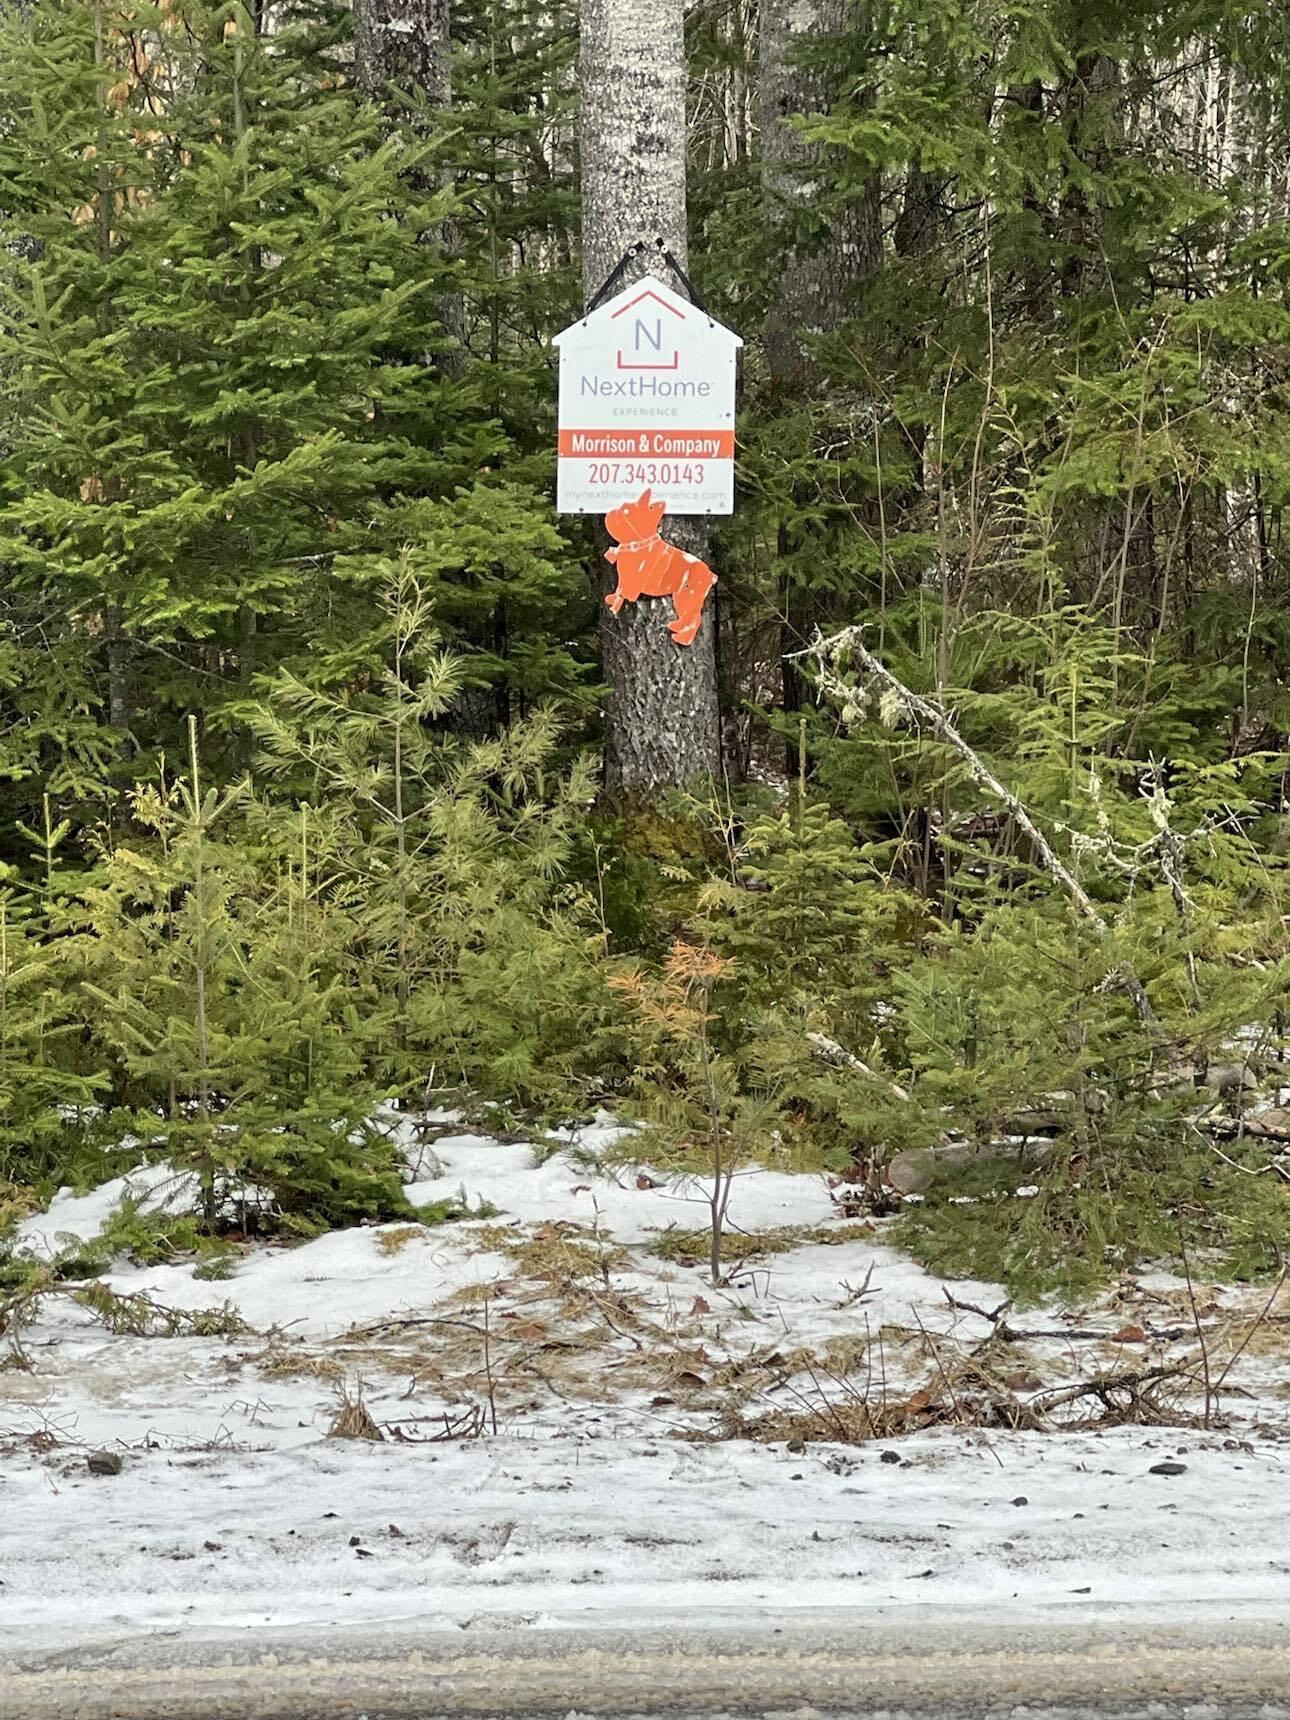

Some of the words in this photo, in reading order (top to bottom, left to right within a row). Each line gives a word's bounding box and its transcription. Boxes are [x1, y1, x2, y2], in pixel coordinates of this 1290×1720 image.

[635, 318, 662, 351] N
[580, 375, 711, 397] NextHome
[612, 407, 679, 417] EXPERIENCE
[571, 434, 636, 453] Morrison
[639, 434, 650, 453] &
[653, 434, 721, 458] Company
[588, 463, 705, 484] 207.343.0143
